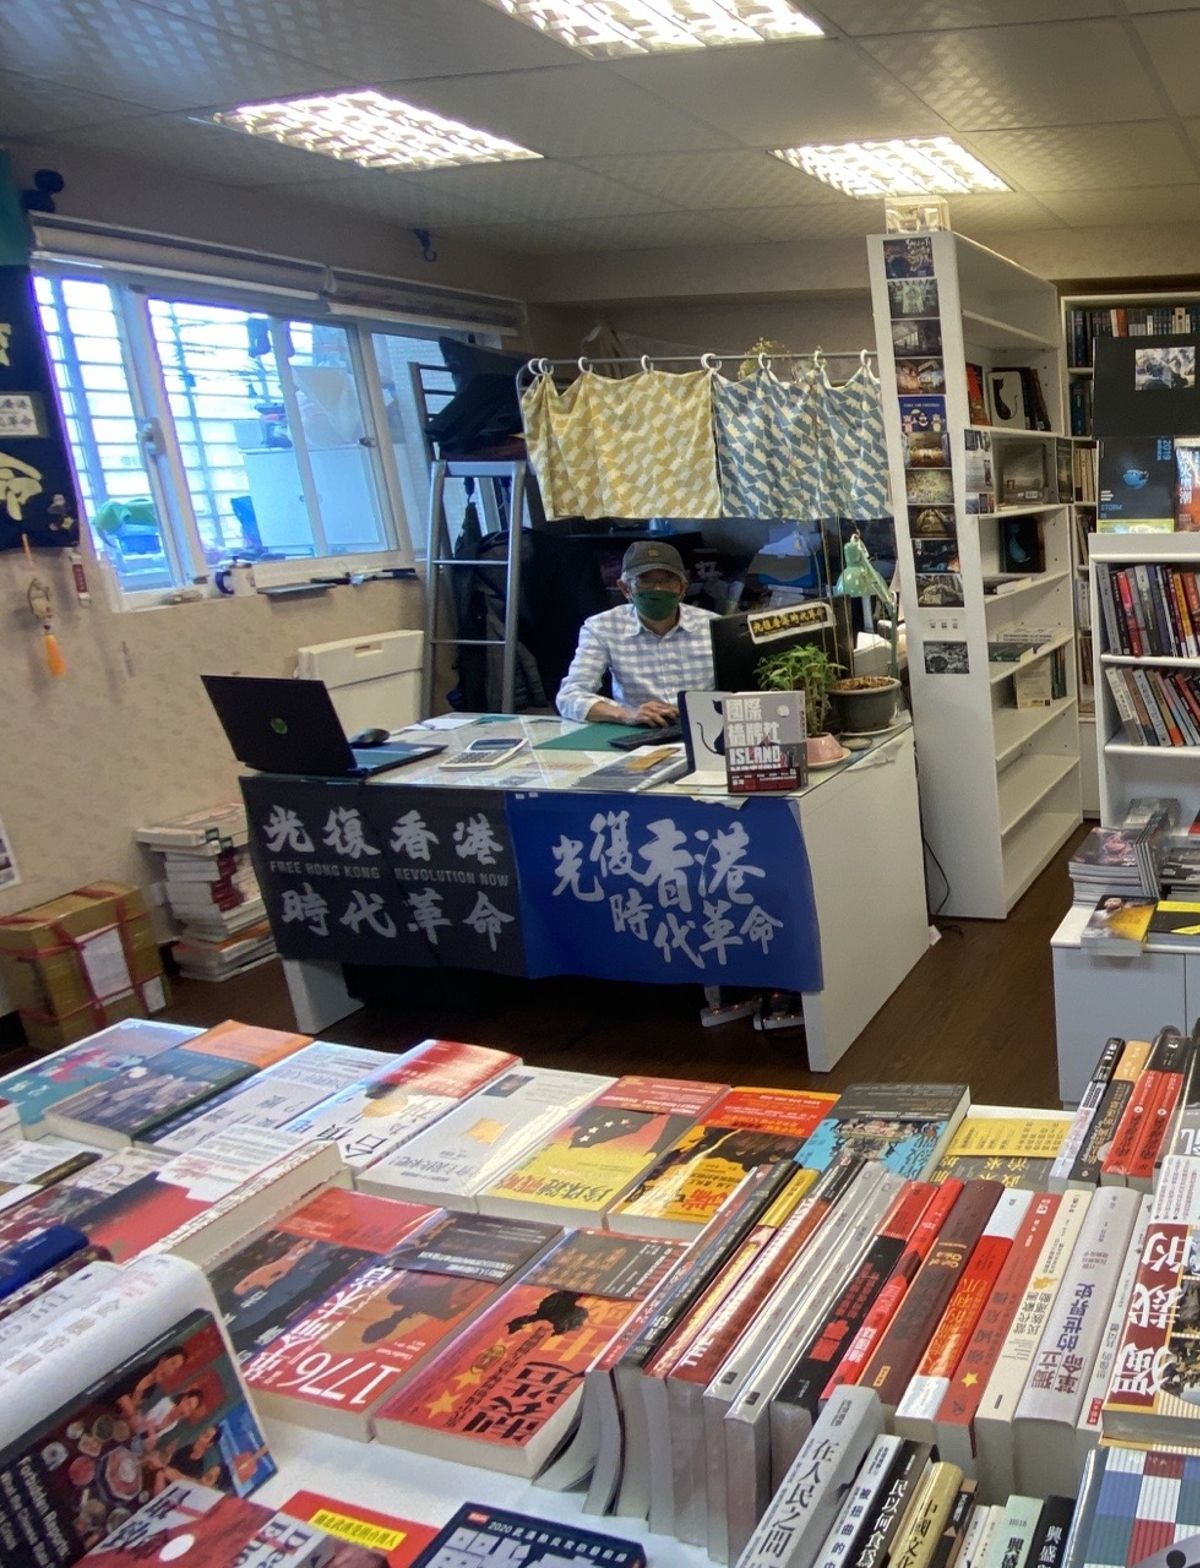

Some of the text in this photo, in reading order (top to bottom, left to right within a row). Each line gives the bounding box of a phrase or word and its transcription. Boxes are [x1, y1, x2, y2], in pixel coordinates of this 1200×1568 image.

[729, 745, 781, 766] ISLAND
[263, 804, 504, 866] 光復香港
[552, 810, 766, 911] 光復香港
[270, 861, 509, 888] FREE HONG KONG REVOLUTION NOW
[281, 882, 516, 952] 時代革命
[609, 893, 784, 968] 時代革命
[1111, 1235, 1192, 1396] 獨裁的
[276, 1351, 401, 1405] 1776
[487, 1520, 512, 1533] 2020
